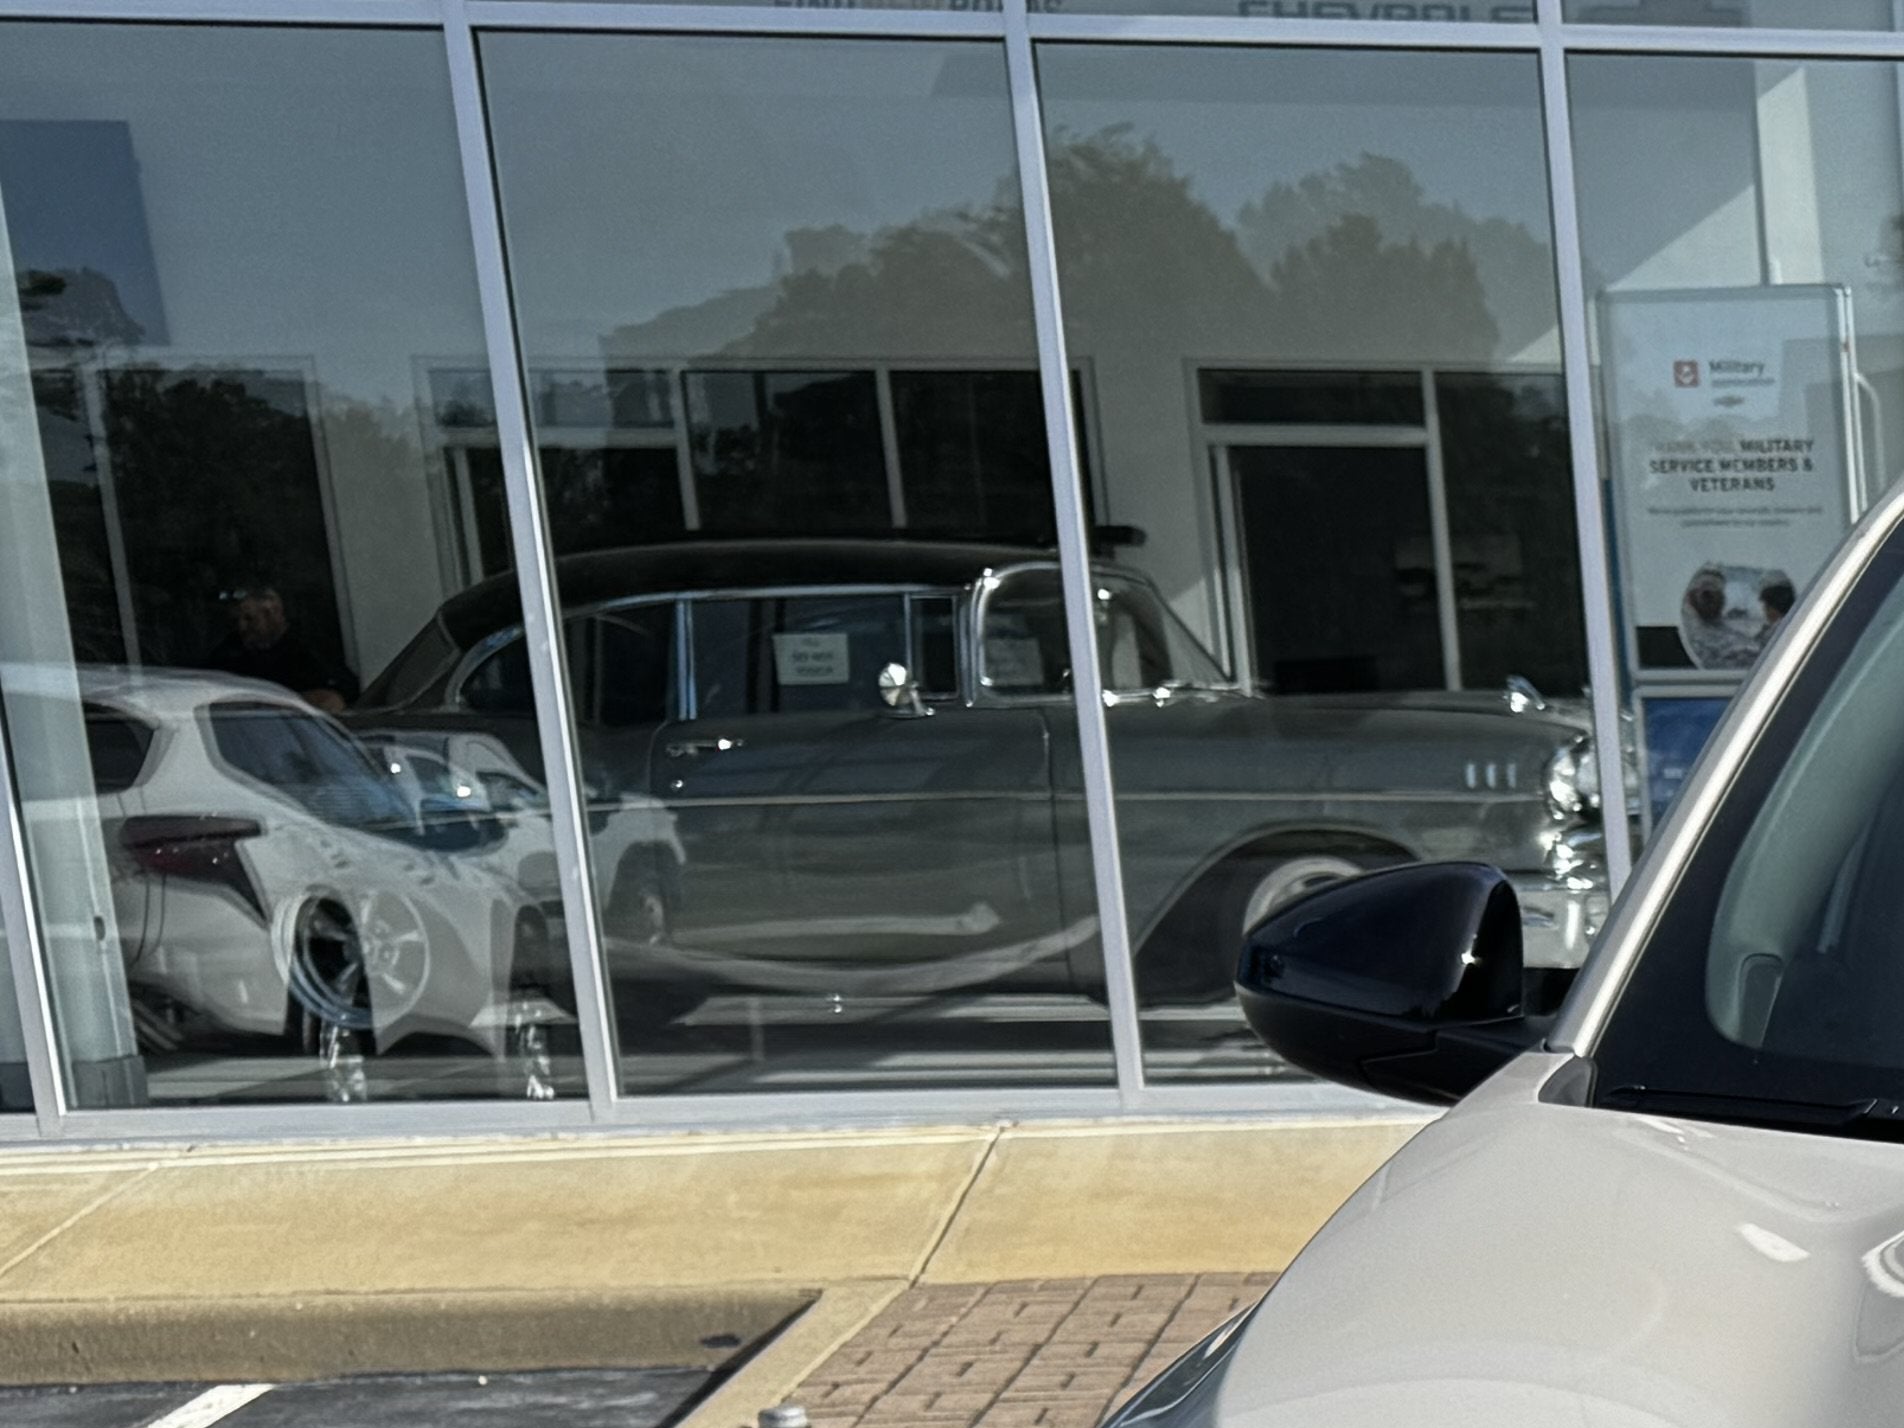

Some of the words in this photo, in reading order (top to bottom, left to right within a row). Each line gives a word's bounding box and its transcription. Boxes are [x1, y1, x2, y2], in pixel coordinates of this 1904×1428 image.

[1740, 439, 1813, 453] MILITARY
[1650, 458, 1713, 473] SERVICE
[1720, 458, 1798, 473] MEMBERS
[1690, 477, 1775, 492] VETERANS
